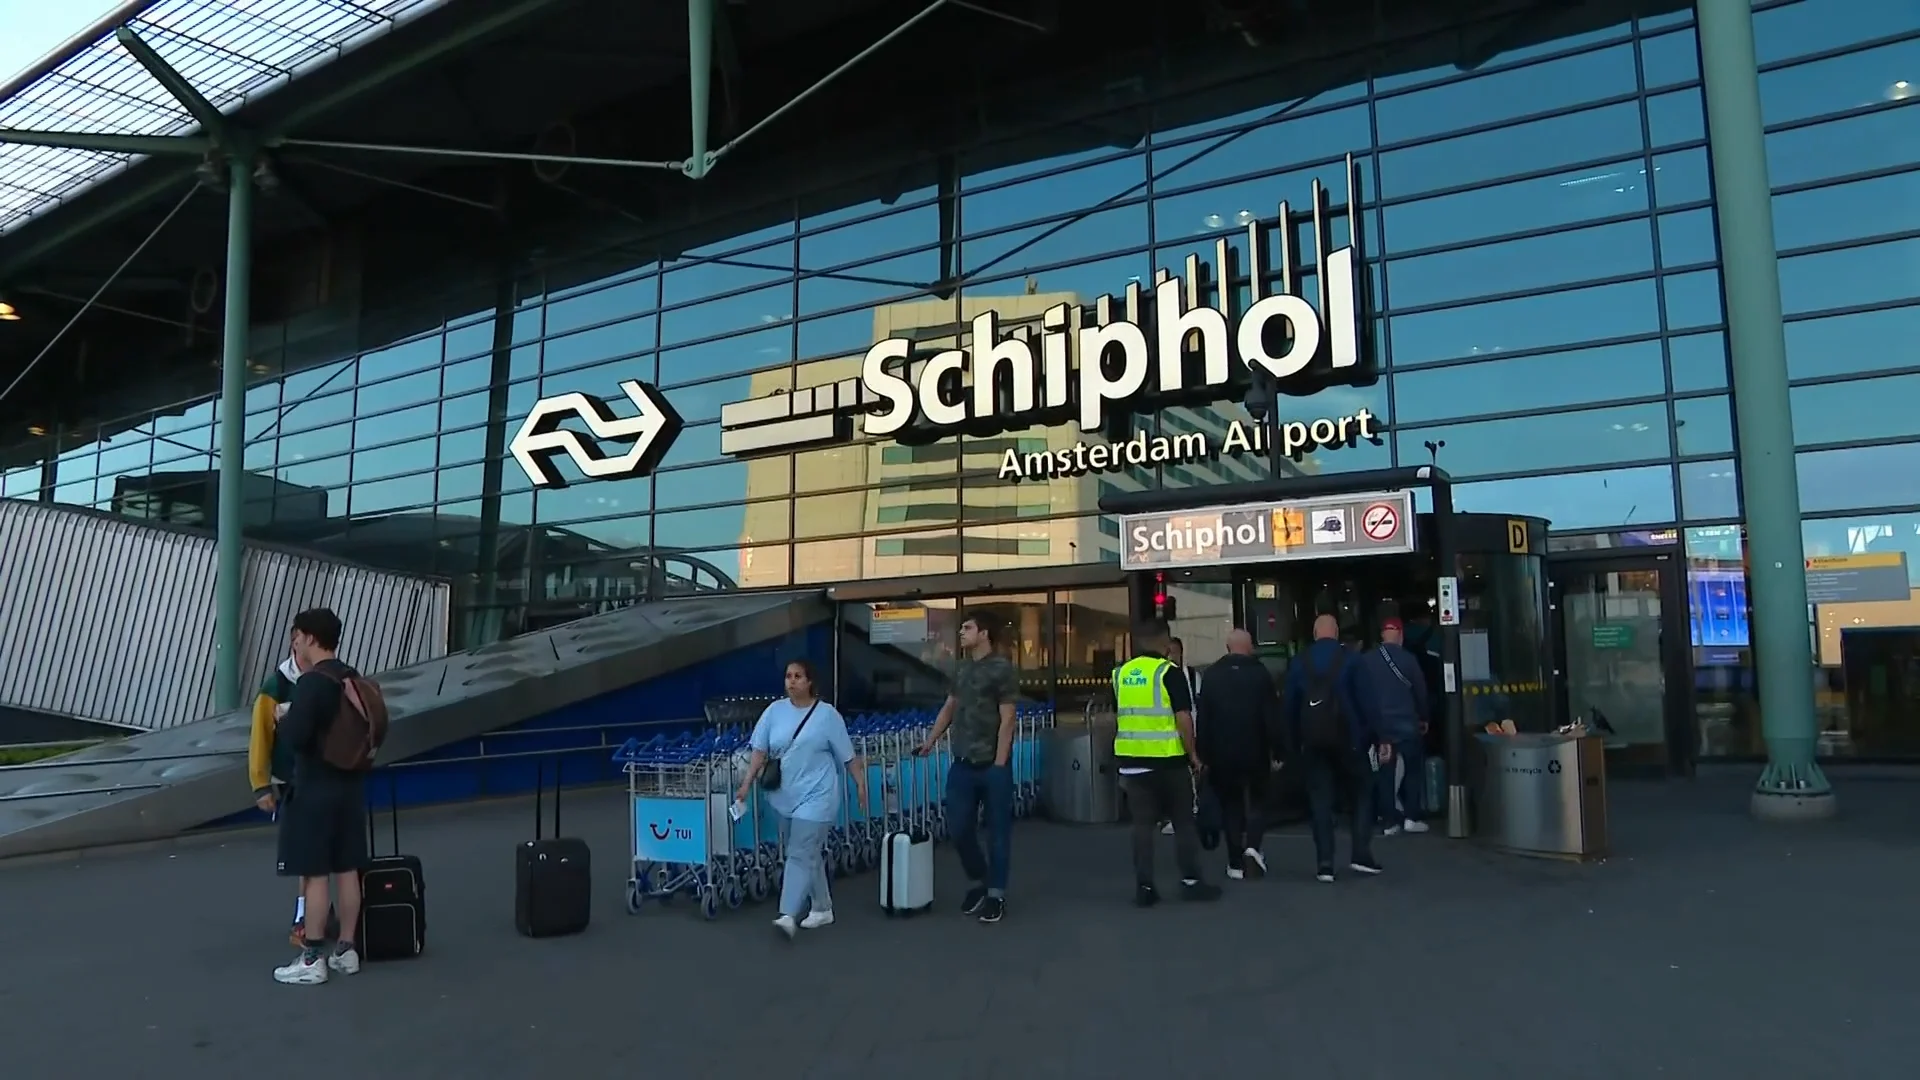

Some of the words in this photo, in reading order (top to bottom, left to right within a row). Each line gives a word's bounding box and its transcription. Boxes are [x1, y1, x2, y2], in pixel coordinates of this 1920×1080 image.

[861, 244, 1358, 435] Schiphol
[998, 430, 1207, 479] Amsterdam
[1222, 407, 1375, 457] Aiport
[1132, 514, 1266, 555] Schiphol
[1512, 524, 1525, 549] D
[1122, 677, 1147, 685] KLM
[674, 828, 692, 840] TUI
